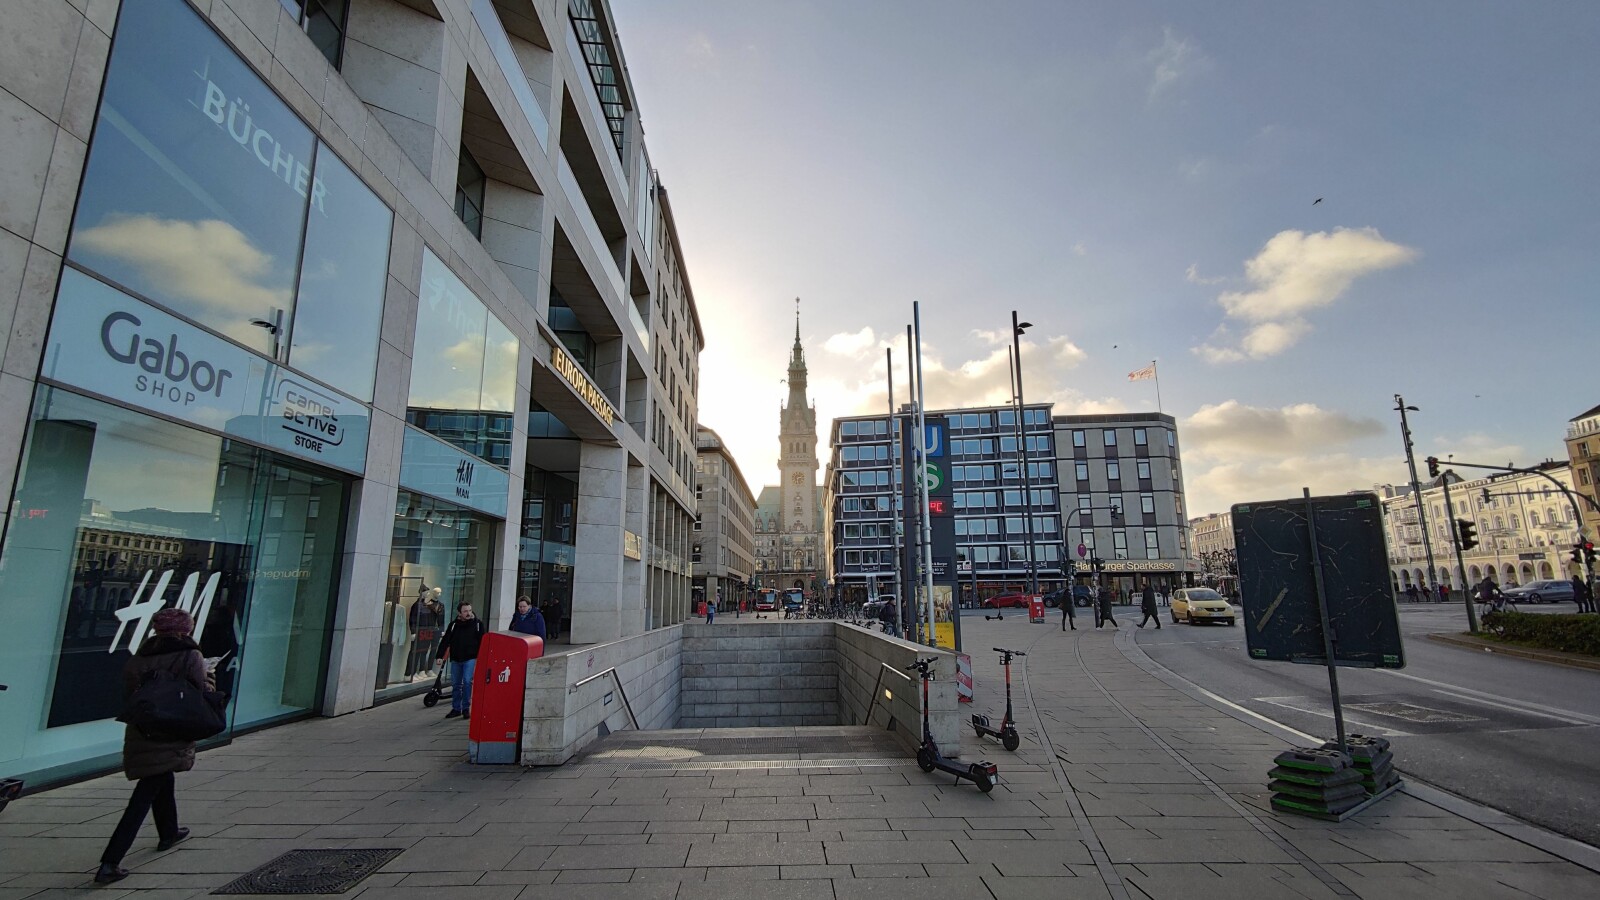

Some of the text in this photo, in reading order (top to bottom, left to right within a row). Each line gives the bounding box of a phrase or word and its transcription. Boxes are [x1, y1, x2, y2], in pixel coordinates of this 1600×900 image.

[202, 80, 327, 215] BÜCHER
[101, 311, 232, 397] Gabor
[135, 375, 196, 406] SHOP
[556, 347, 614, 428] EUROPA PASSAGE
[294, 435, 323, 453] STORE
[913, 426, 938, 454] U
[456, 459, 474, 487] H&M
[916, 463, 940, 490] S
[456, 486, 470, 499] MAN
[1126, 561, 1175, 571] Sparkasse
